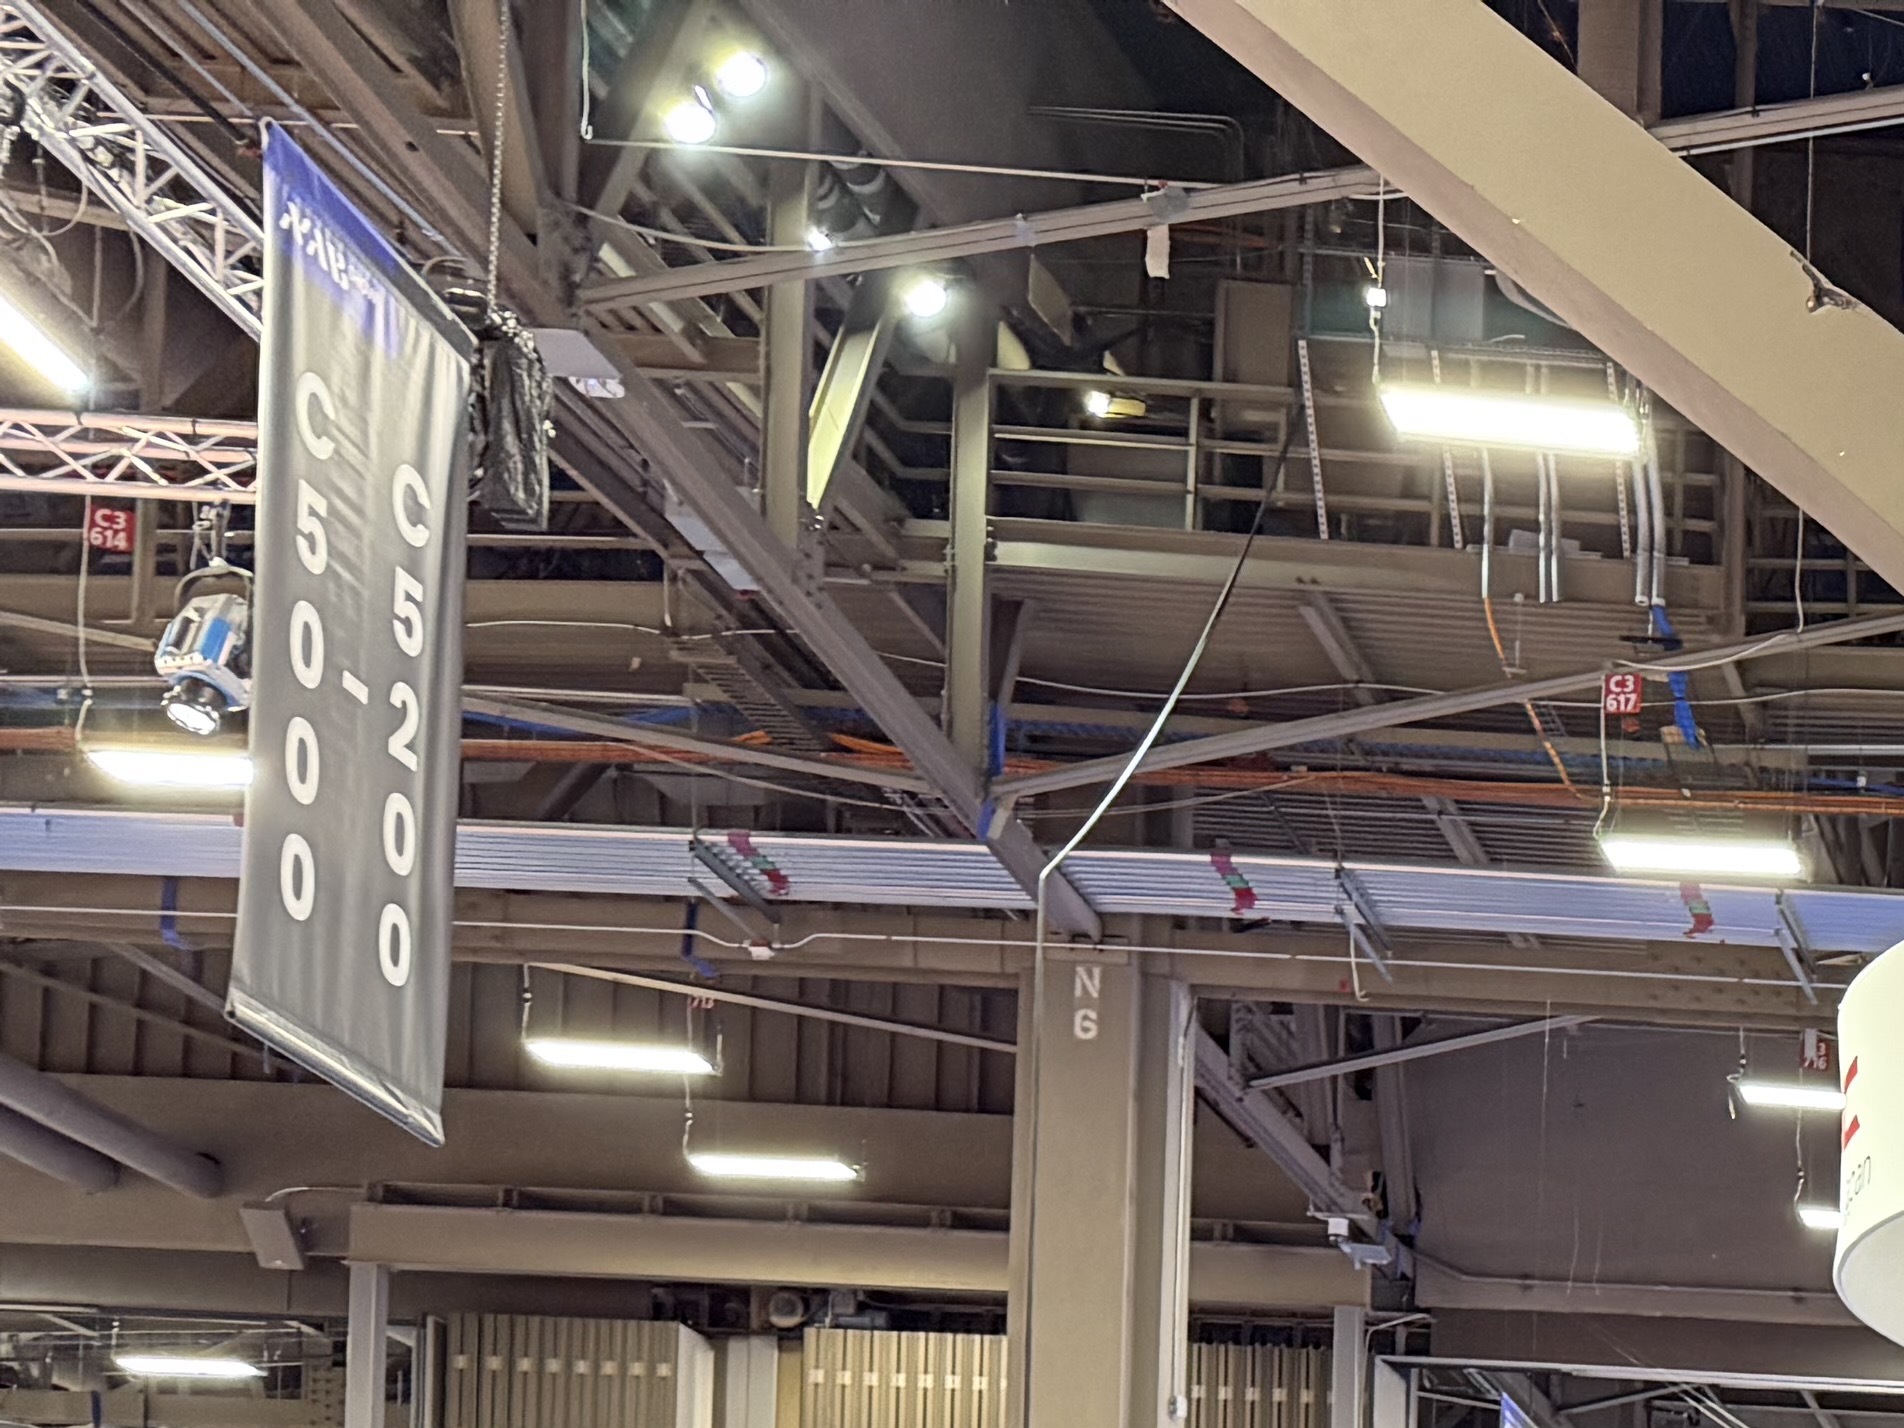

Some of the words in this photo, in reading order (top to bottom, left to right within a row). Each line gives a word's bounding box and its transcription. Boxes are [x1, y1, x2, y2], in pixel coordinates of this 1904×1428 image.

[94, 508, 127, 530] C3
[89, 527, 128, 551] 614
[1609, 674, 1635, 693] C3
[1606, 693, 1638, 712] 617
